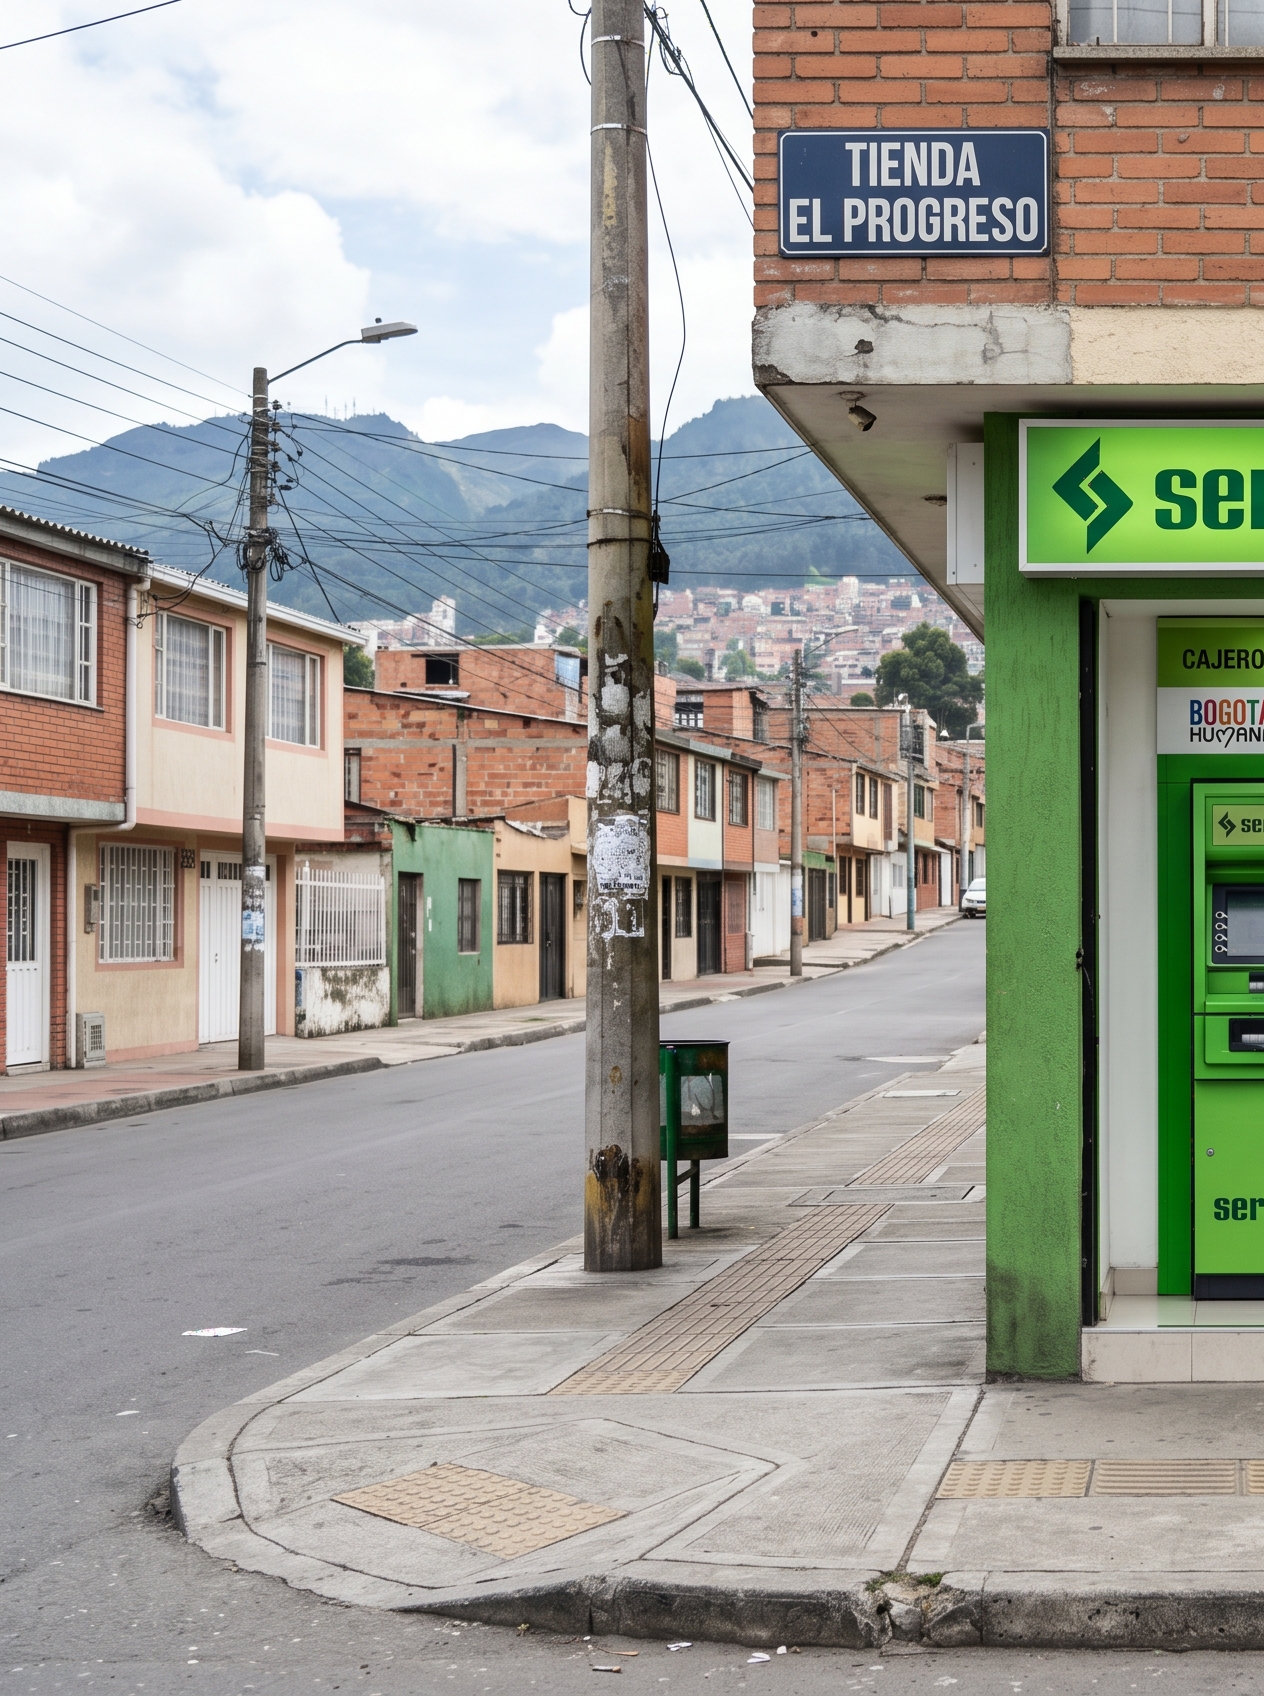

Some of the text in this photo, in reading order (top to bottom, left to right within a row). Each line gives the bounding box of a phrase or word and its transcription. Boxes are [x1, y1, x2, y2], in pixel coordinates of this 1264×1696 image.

[845, 141, 981, 187] TIENDA
[789, 196, 1039, 243] EL PROGRESO
[1182, 648, 1264, 670] CAJERO
